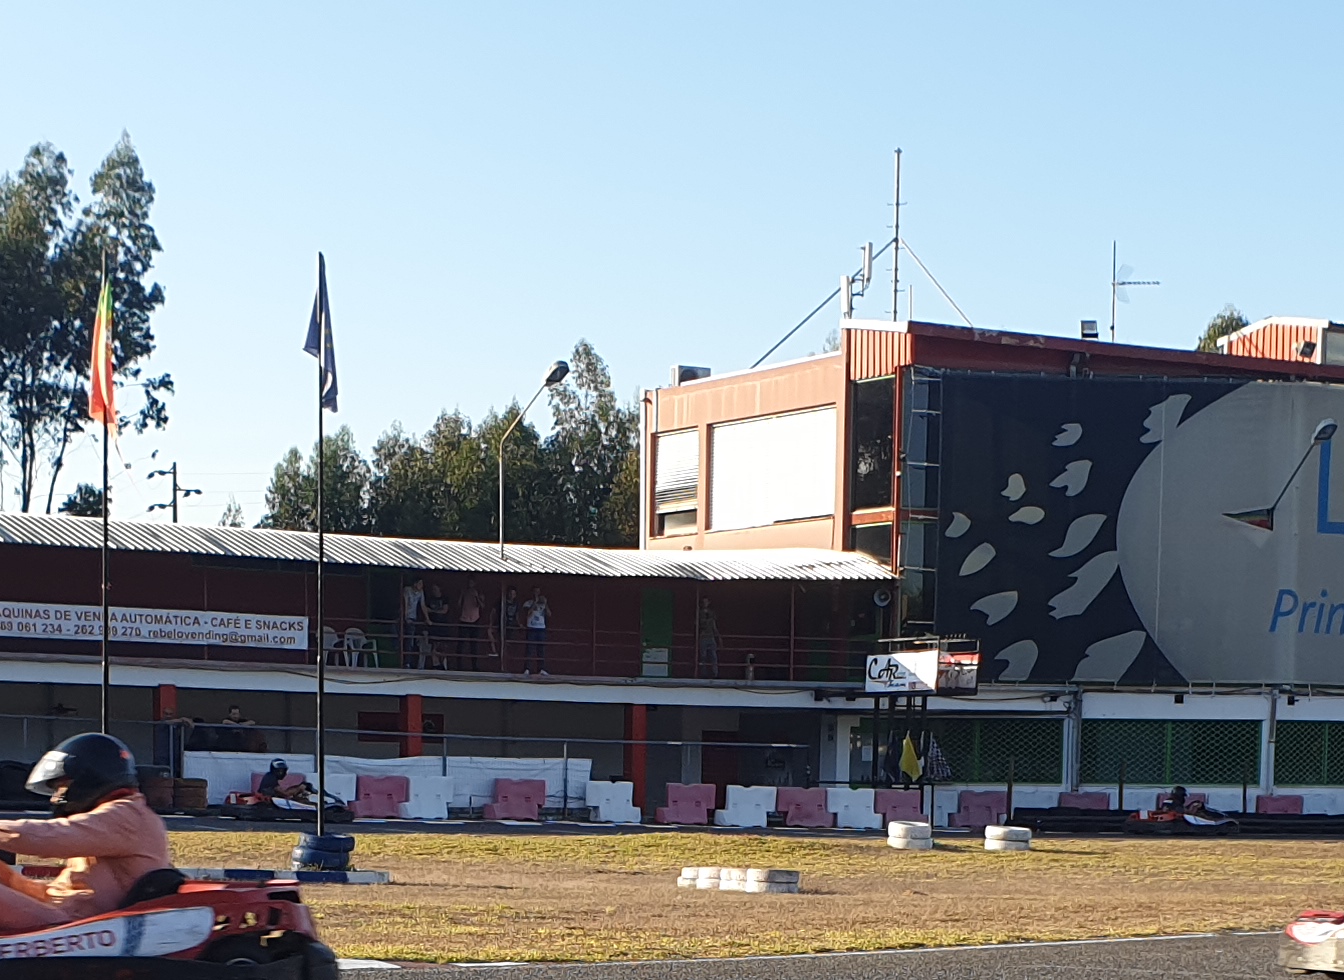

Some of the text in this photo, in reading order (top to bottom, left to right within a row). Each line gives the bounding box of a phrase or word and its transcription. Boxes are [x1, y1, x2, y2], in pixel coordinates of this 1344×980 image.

[54, 609, 72, 621] DE
[120, 612, 201, 627] AUTOMÁTICA
[210, 616, 241, 629] CAFÉ
[244, 619, 252, 630] E
[255, 619, 304, 632] SNACKS
[42, 623, 63, 634] 234
[74, 624, 95, 635] 262
[121, 626, 142, 637] 270
[147, 626, 296, 645] rebelovending@gmail.com
